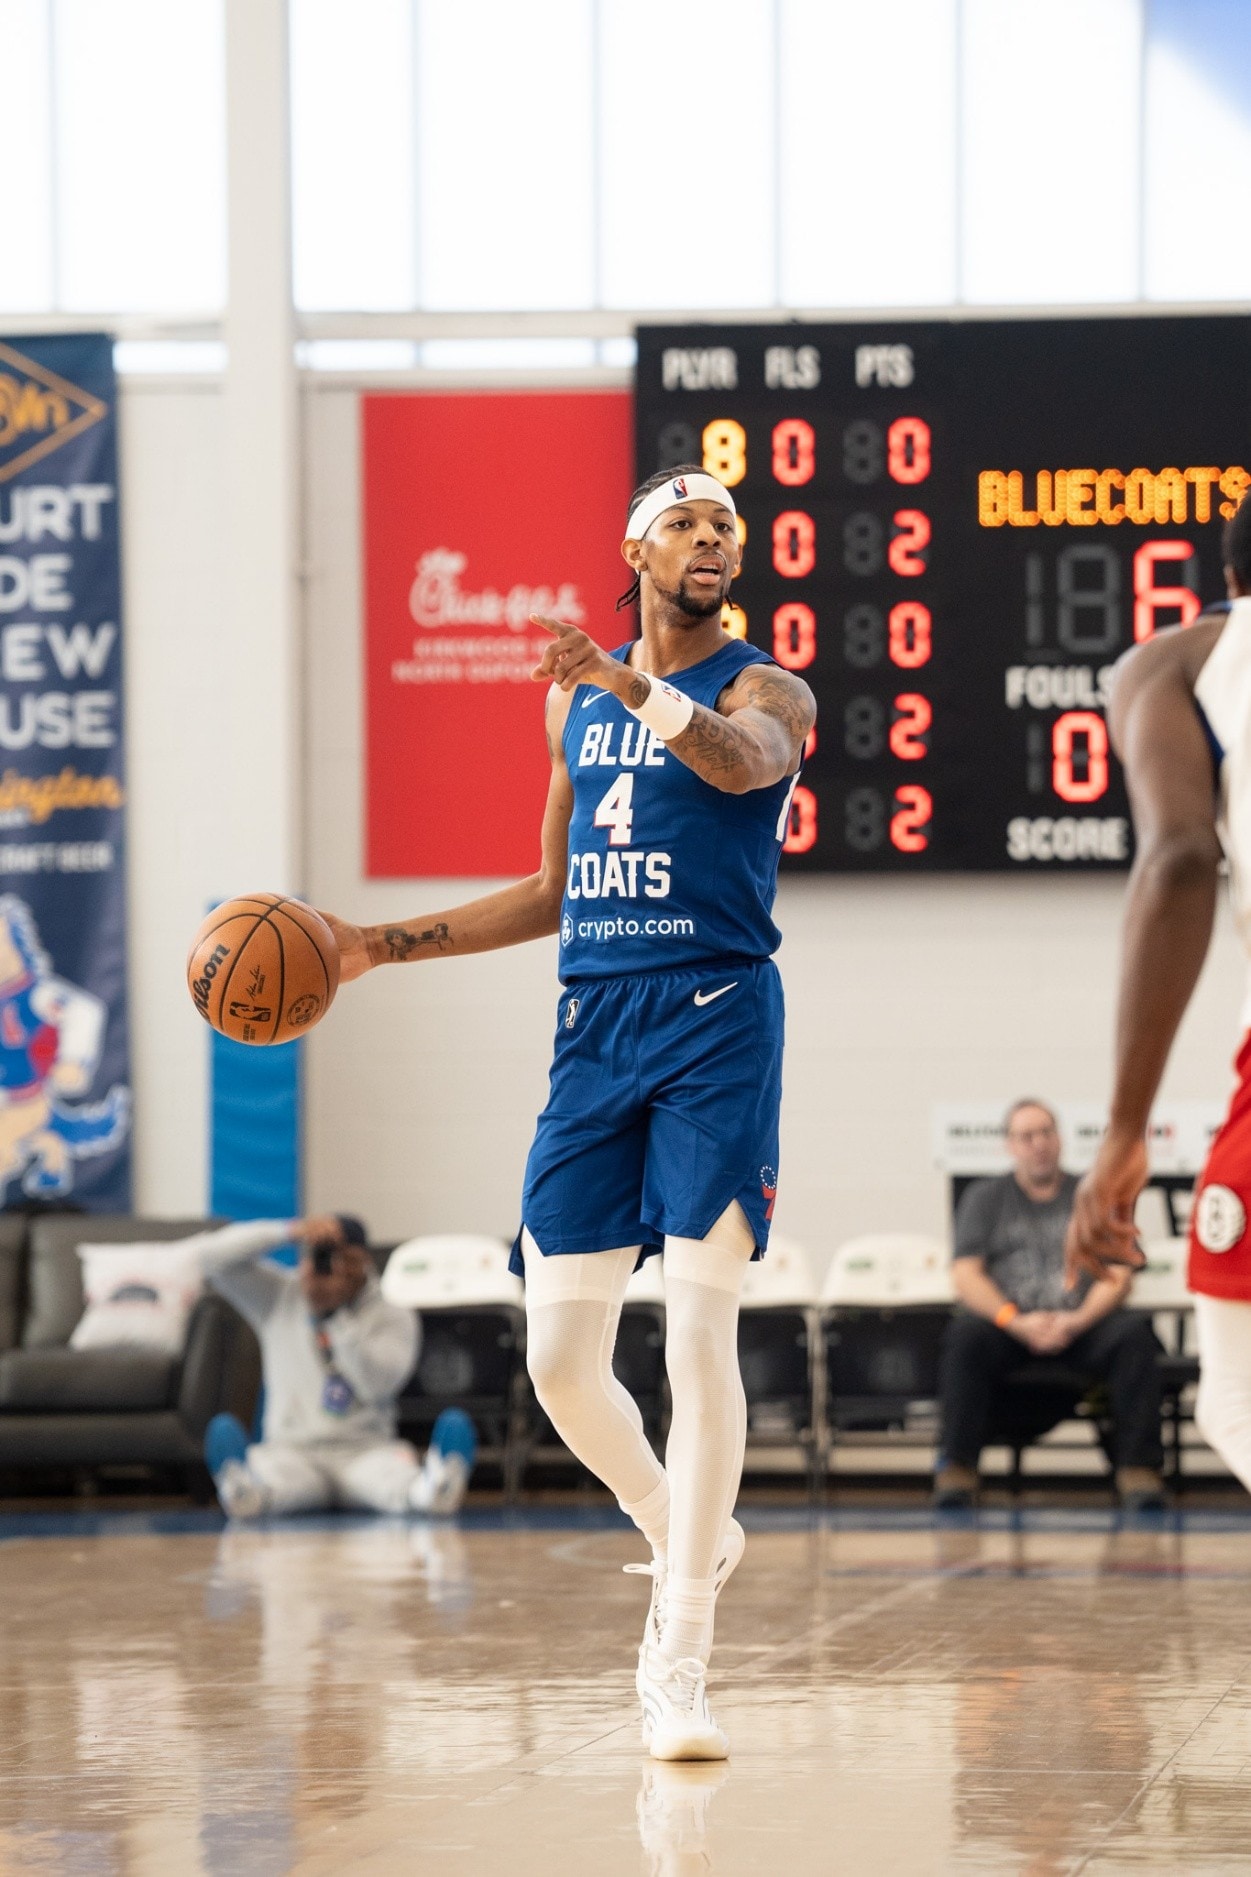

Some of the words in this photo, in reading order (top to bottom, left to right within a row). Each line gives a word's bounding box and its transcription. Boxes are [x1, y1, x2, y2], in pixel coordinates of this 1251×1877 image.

[662, 346, 738, 391] PLYR
[764, 345, 821, 390] FLS
[855, 343, 914, 388] PTS
[702, 418, 747, 488] 8
[772, 418, 815, 486] 0
[888, 416, 931, 484] 0
[978, 466, 1251, 527] BLUECOATS
[772, 510, 815, 578] 0
[888, 508, 931, 576] 2
[773, 602, 816, 670] 0
[889, 601, 932, 668] 0
[578, 722, 666, 767] BLUE
[889, 692, 932, 760] 2
[1052, 711, 1109, 803] 0
[593, 772, 634, 846] 4
[889, 784, 932, 852] 2
[1006, 816, 1130, 861] SCORE
[567, 852, 671, 900] COATS
[578, 917, 694, 940] crypto.com
